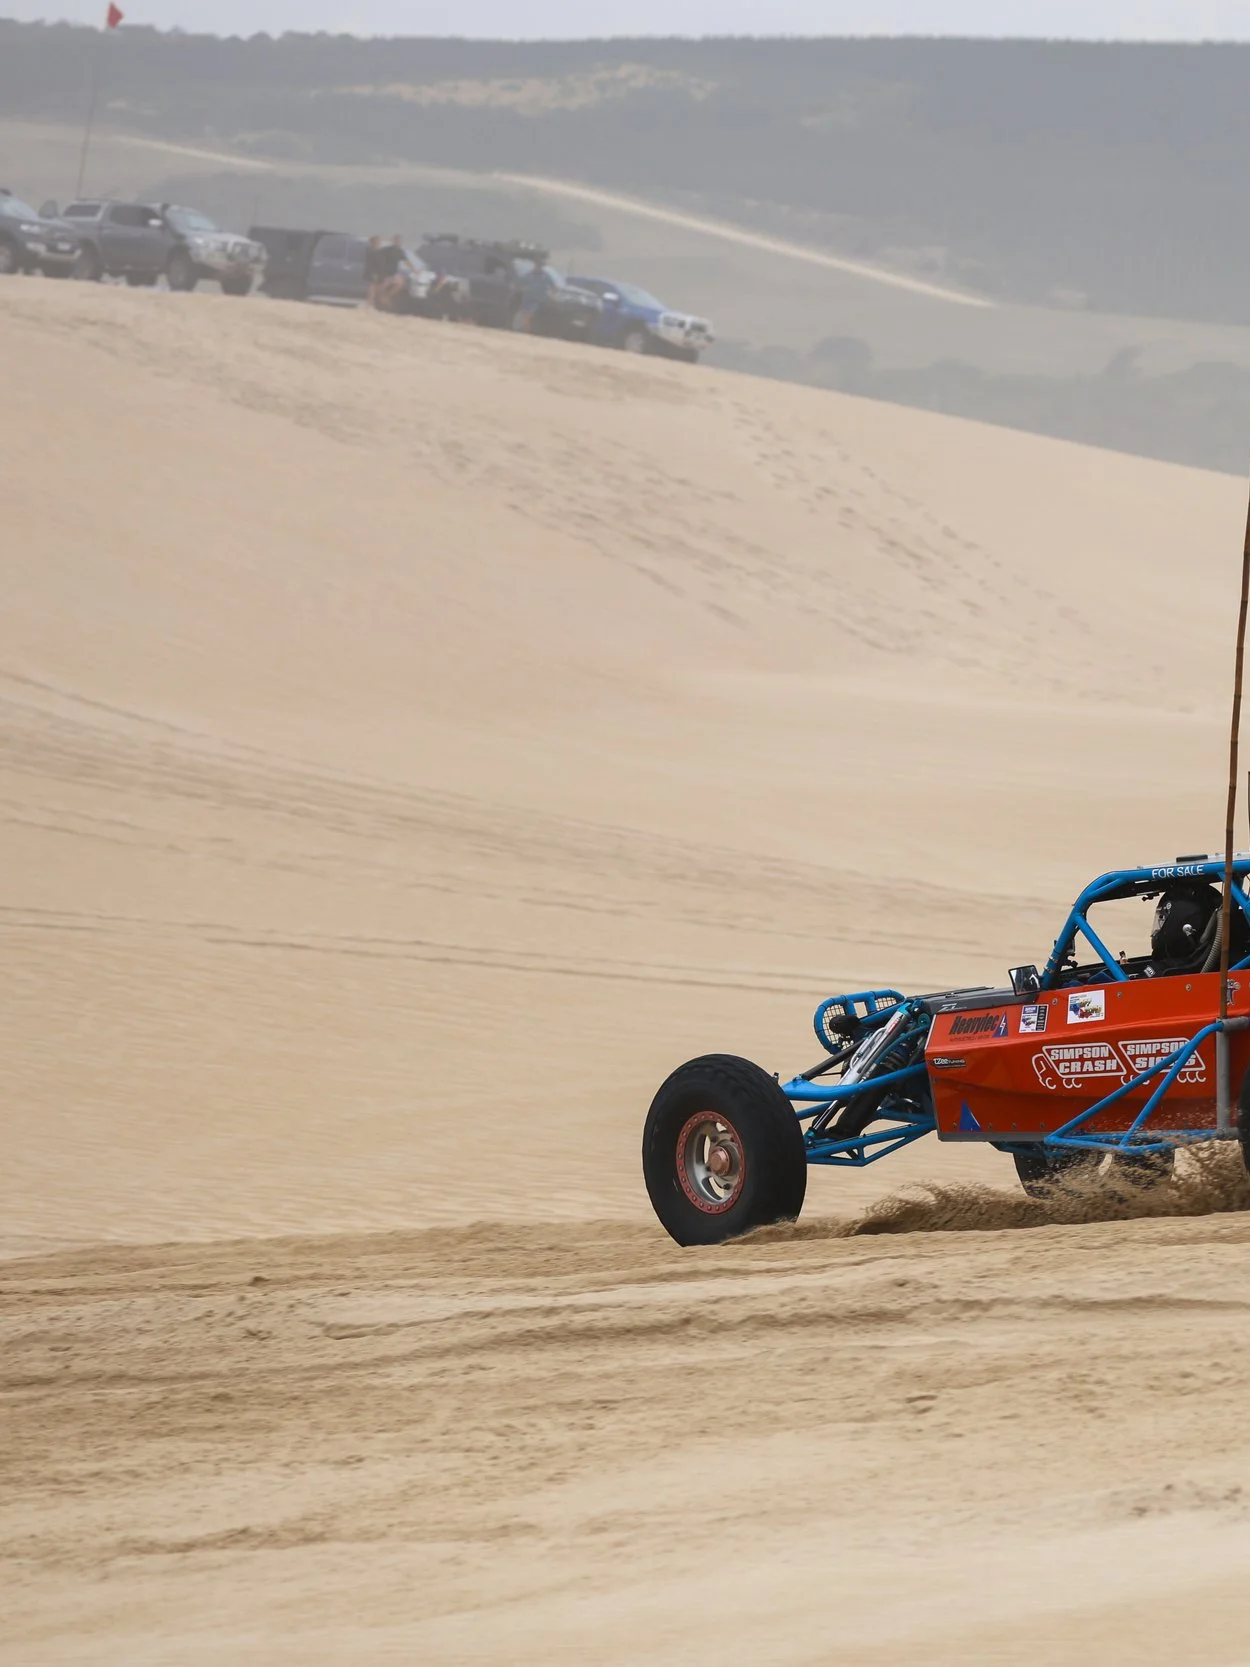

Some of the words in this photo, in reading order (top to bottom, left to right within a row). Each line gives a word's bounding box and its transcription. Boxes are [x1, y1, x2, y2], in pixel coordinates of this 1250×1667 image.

[1152, 867, 1175, 879] FOR
[1177, 865, 1206, 877] SALE
[1050, 1046, 1109, 1060] SIMPSON
[1059, 1059, 1117, 1073] CRASH
[1135, 1055, 1196, 1068] SIS
